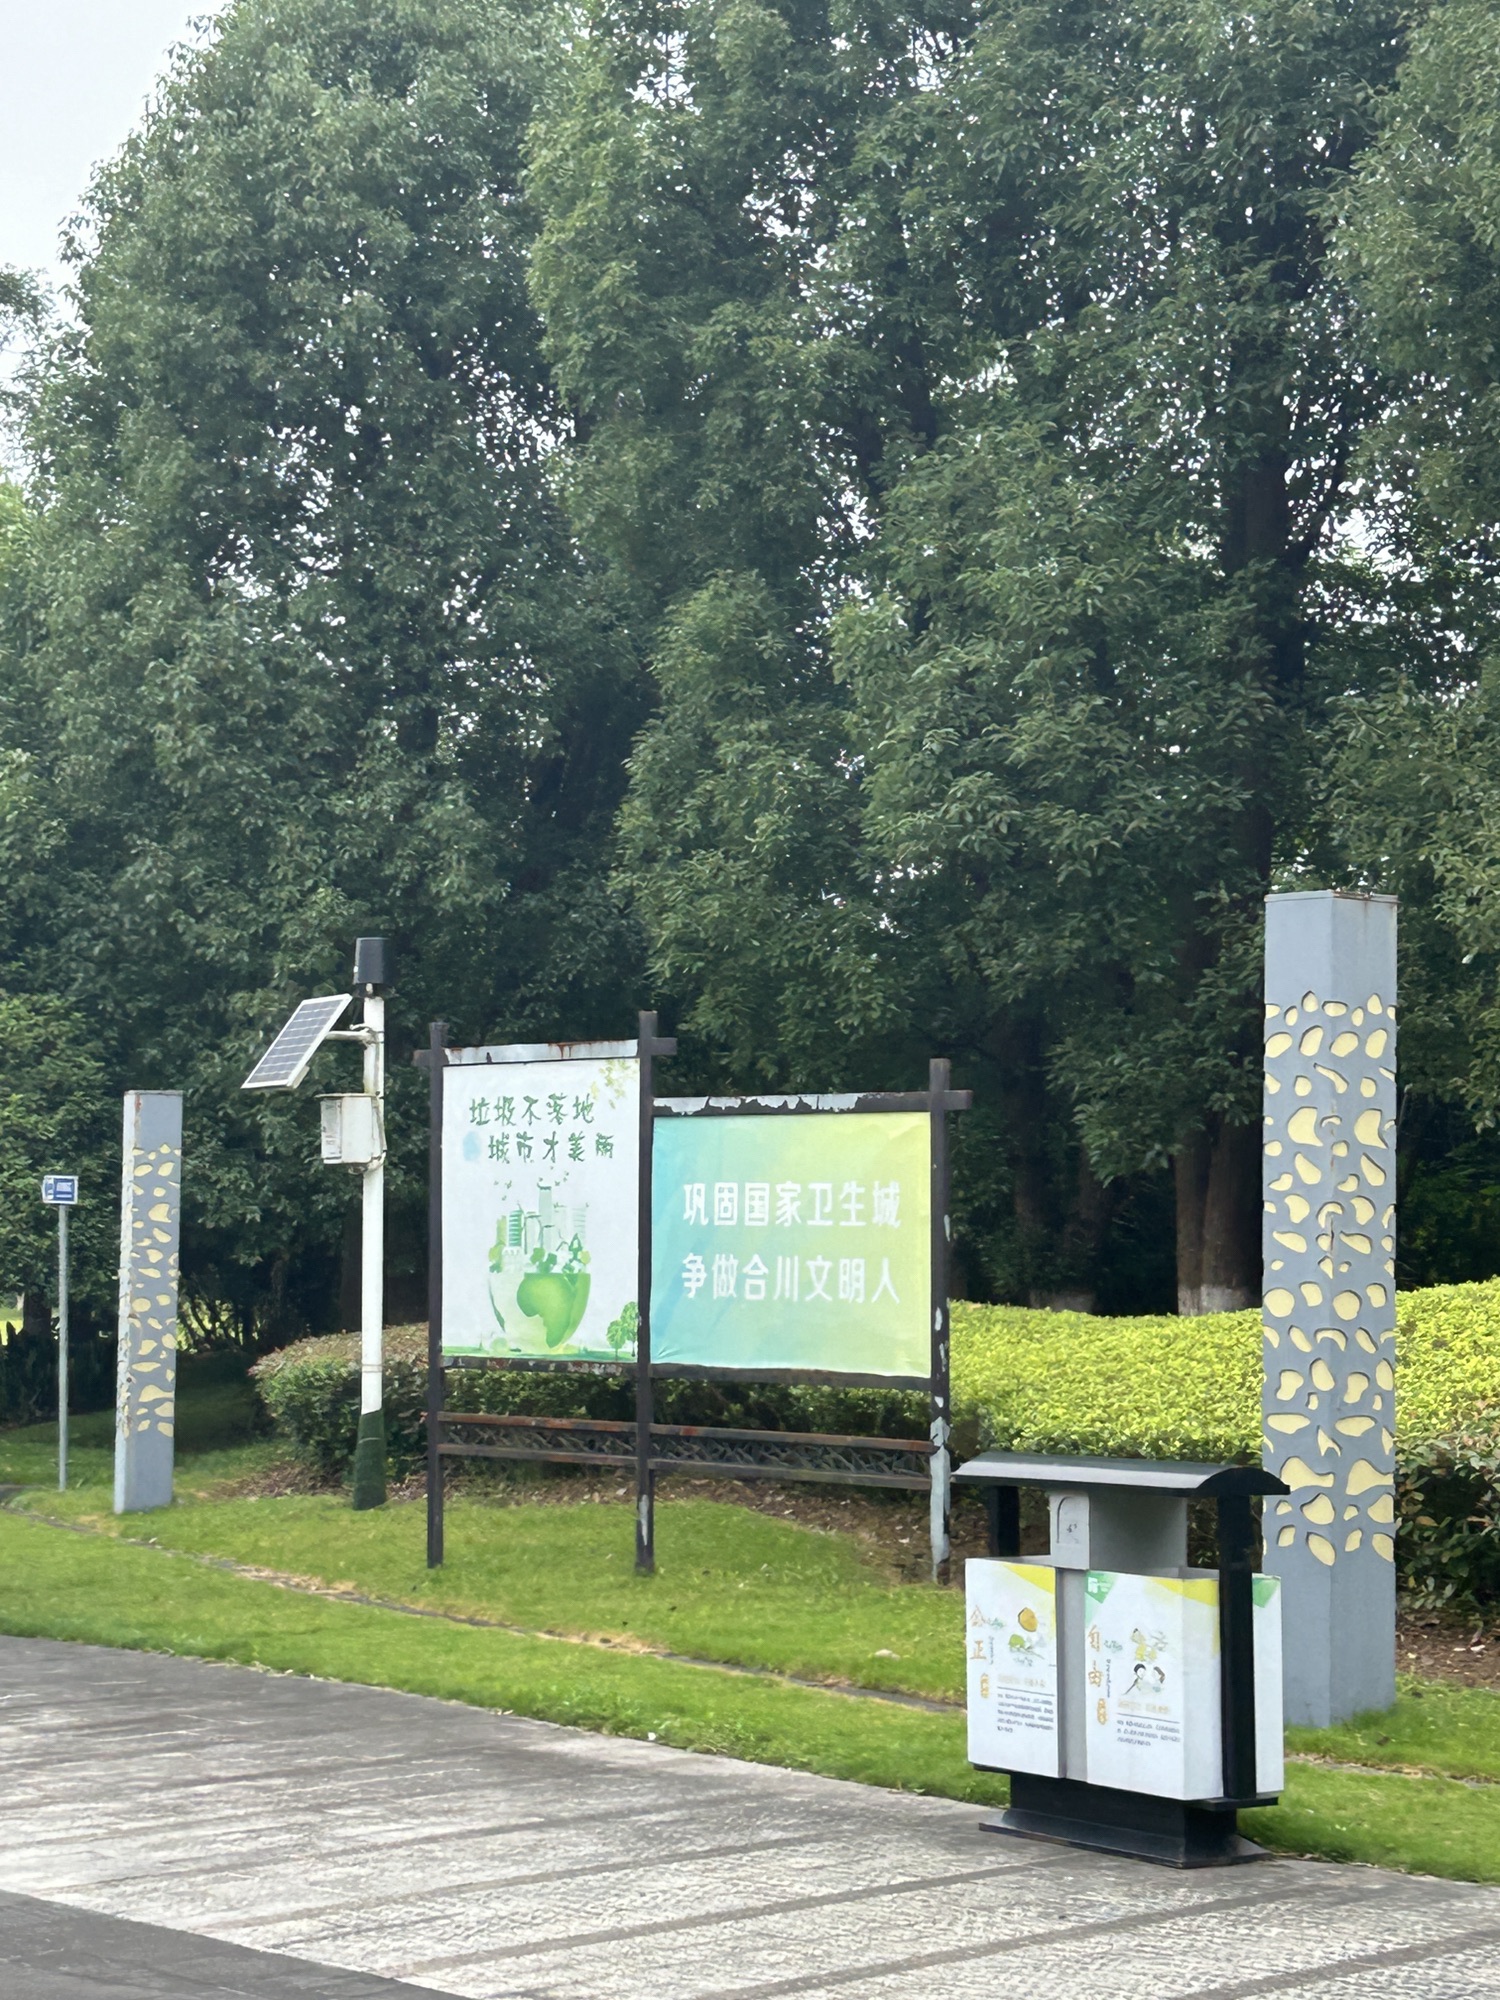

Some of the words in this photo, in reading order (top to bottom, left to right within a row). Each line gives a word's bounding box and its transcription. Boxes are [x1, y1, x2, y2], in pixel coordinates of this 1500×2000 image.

[469, 1093, 595, 1126] 垃圾不落地
[682, 1181, 902, 1229] 巩固国家卫生城
[681, 1252, 901, 1305] 争做合川文明人
